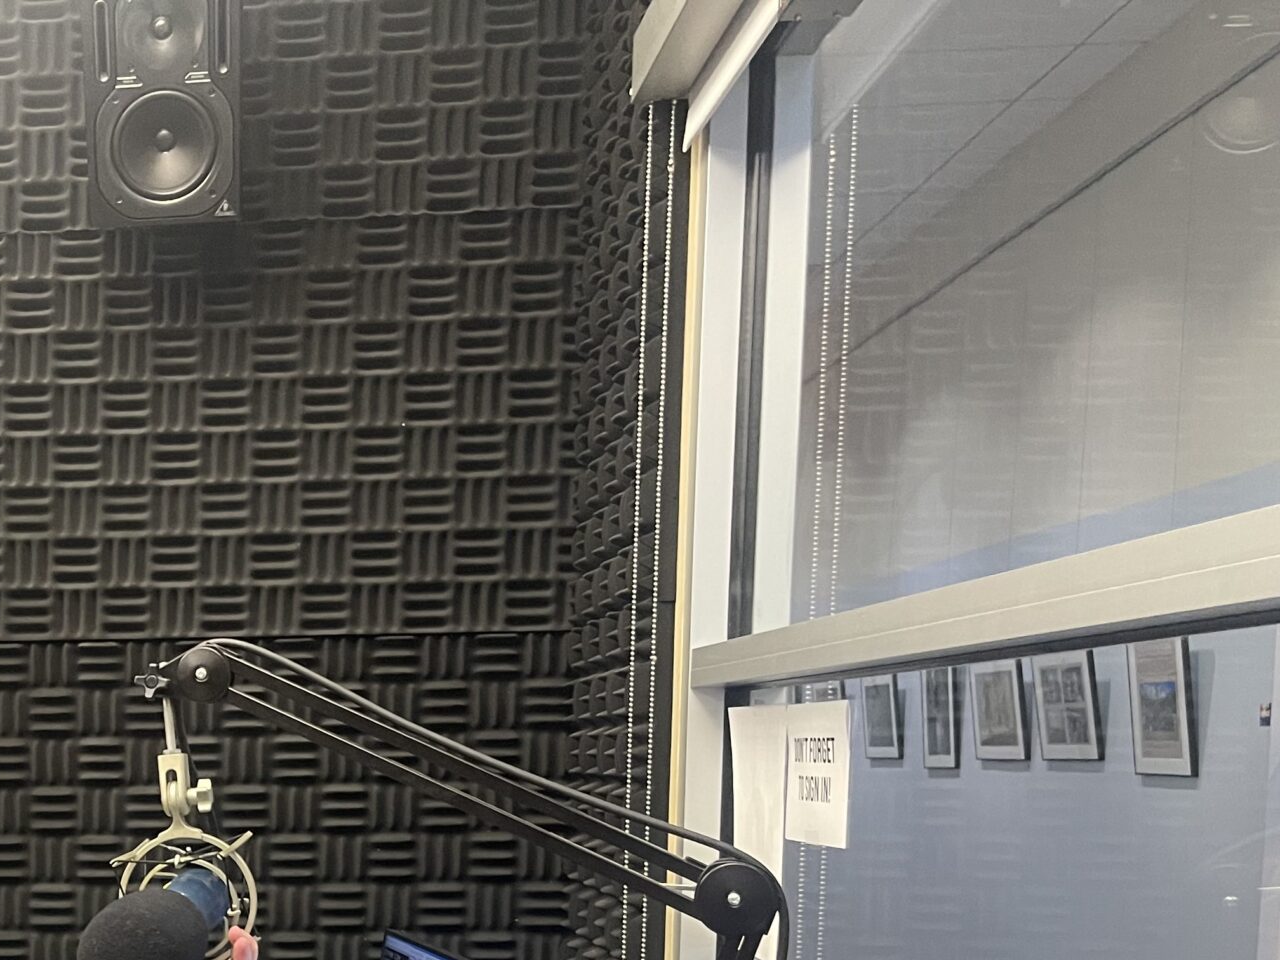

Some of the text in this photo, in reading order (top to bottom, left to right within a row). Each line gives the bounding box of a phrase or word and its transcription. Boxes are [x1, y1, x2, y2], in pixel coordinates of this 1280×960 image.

[794, 737, 835, 764] DON'T FORGET
[798, 775, 831, 803] TO SIGN IN!
